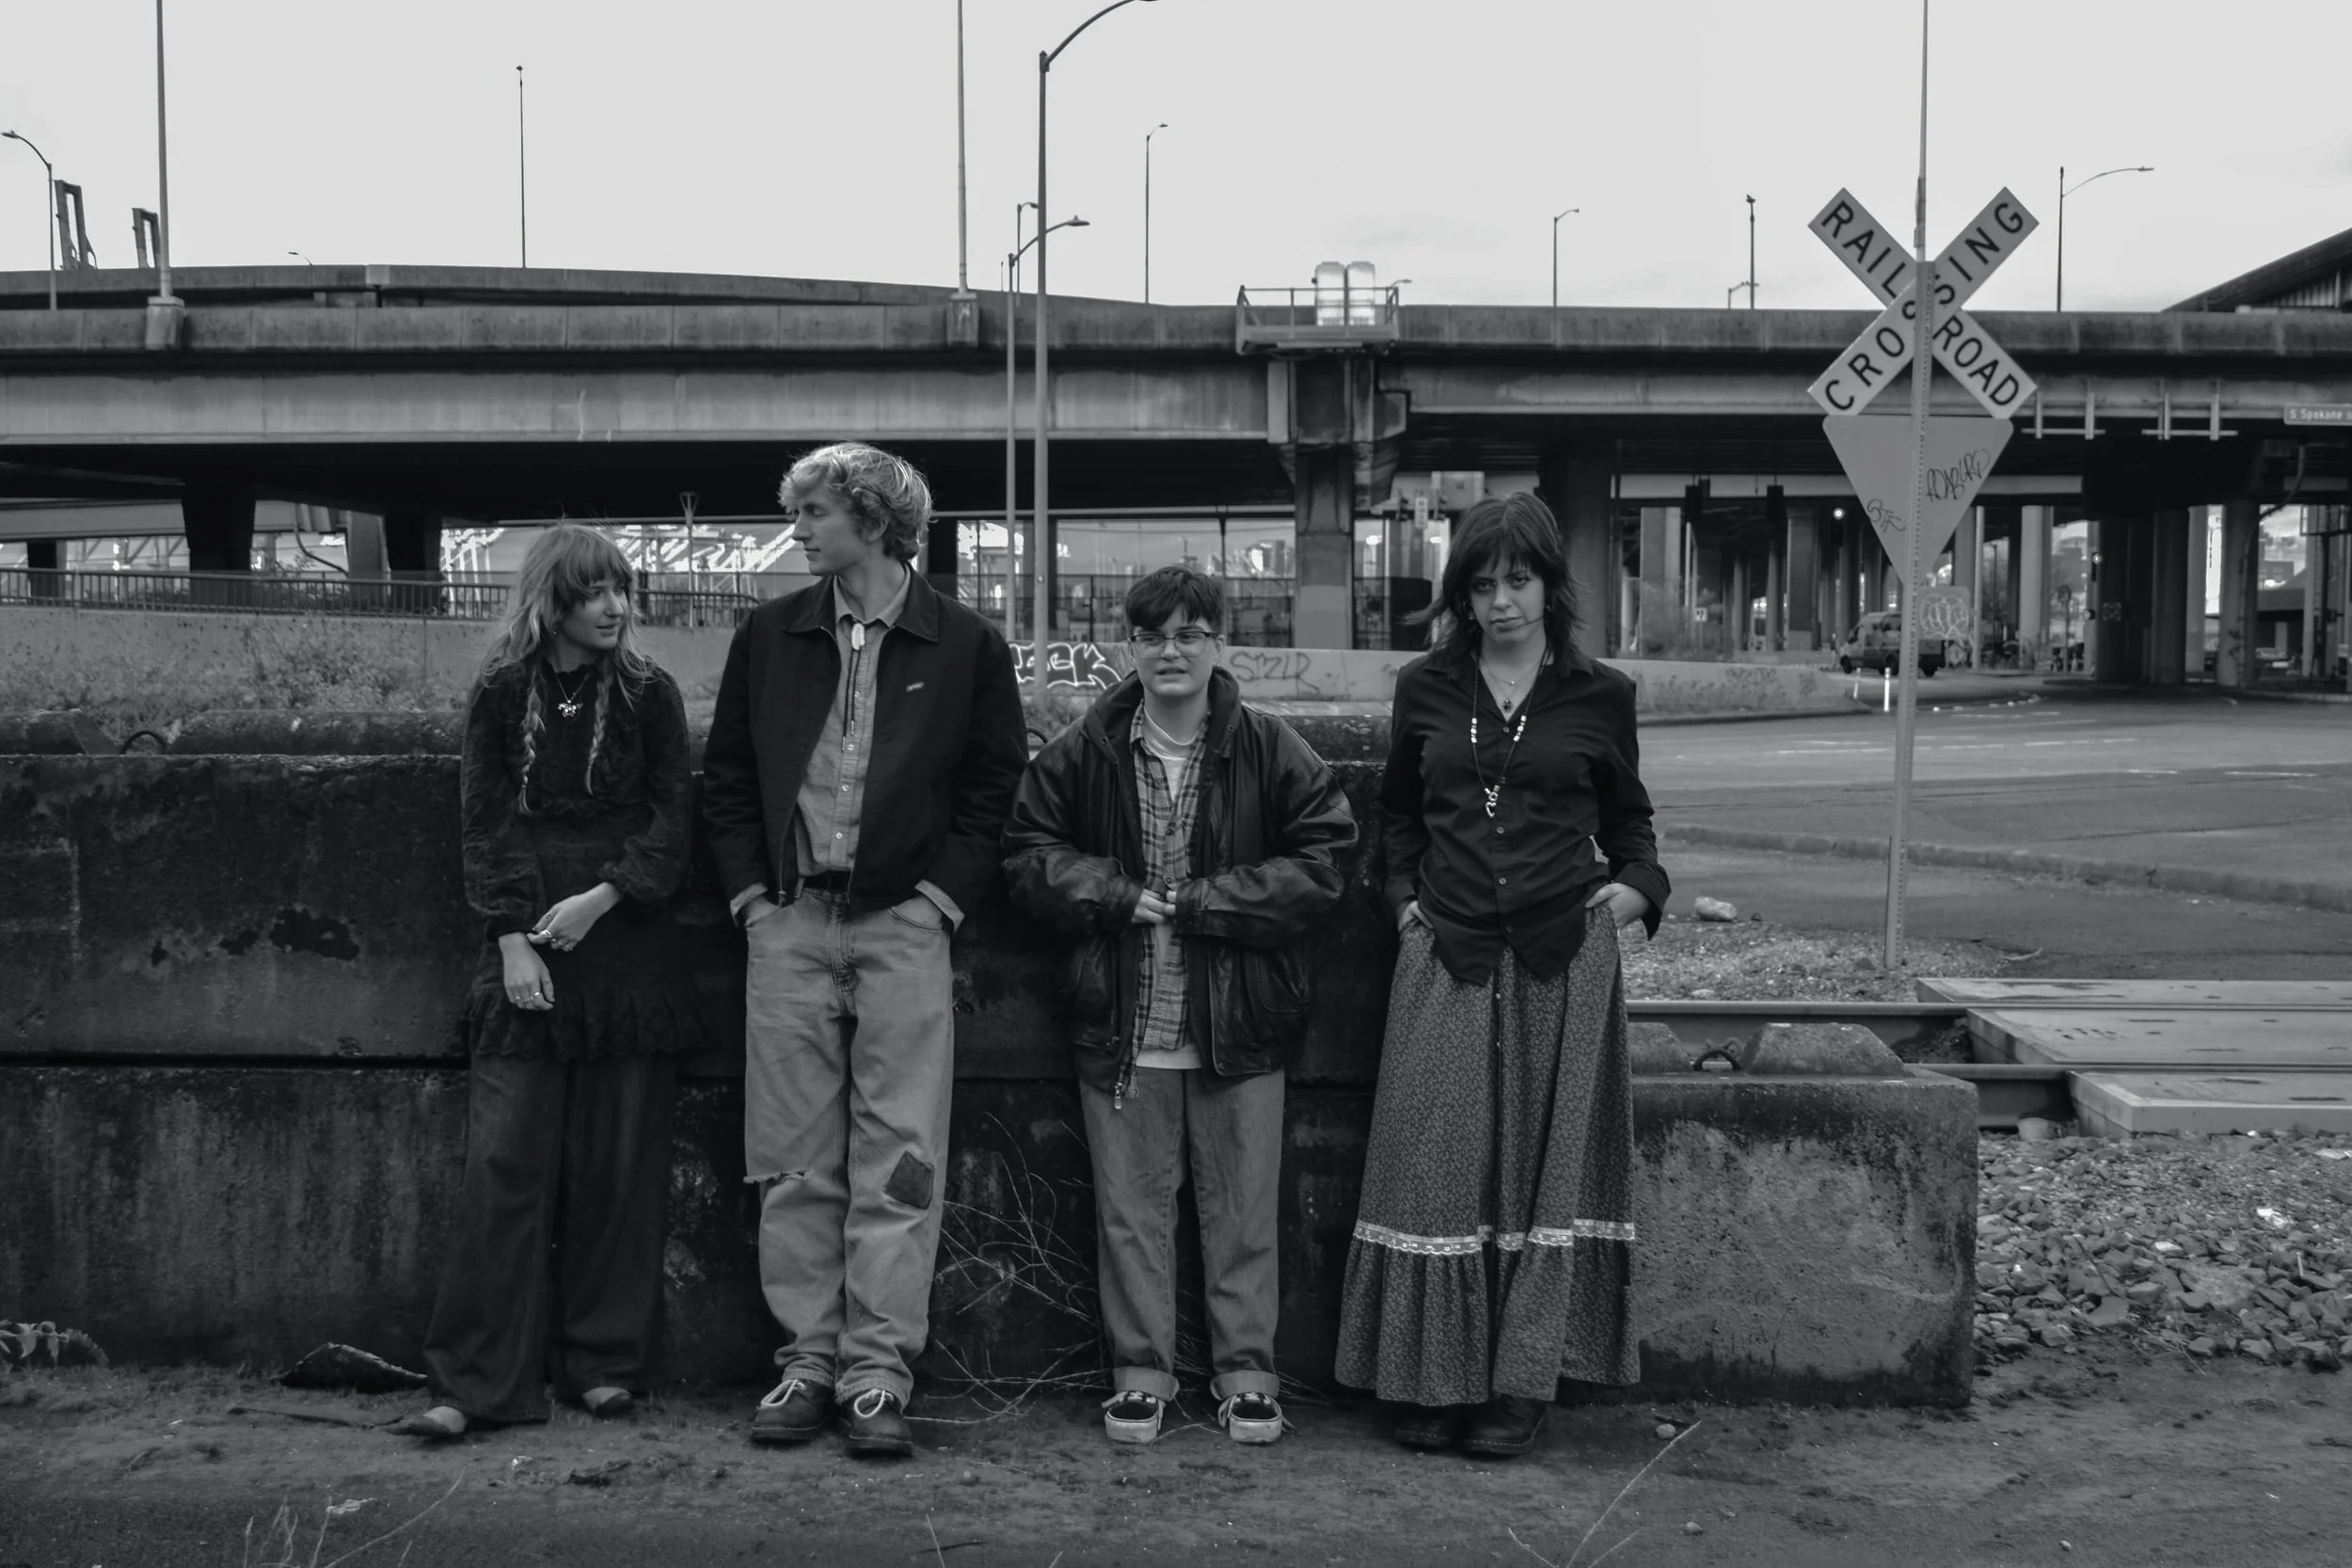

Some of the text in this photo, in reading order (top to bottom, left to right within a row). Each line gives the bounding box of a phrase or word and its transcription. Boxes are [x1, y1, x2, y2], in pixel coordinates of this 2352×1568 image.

[1821, 200, 2020, 406] RAIL ROAD
[2290, 408, 2296, 420] S
[2300, 408, 2343, 422] Spokane
